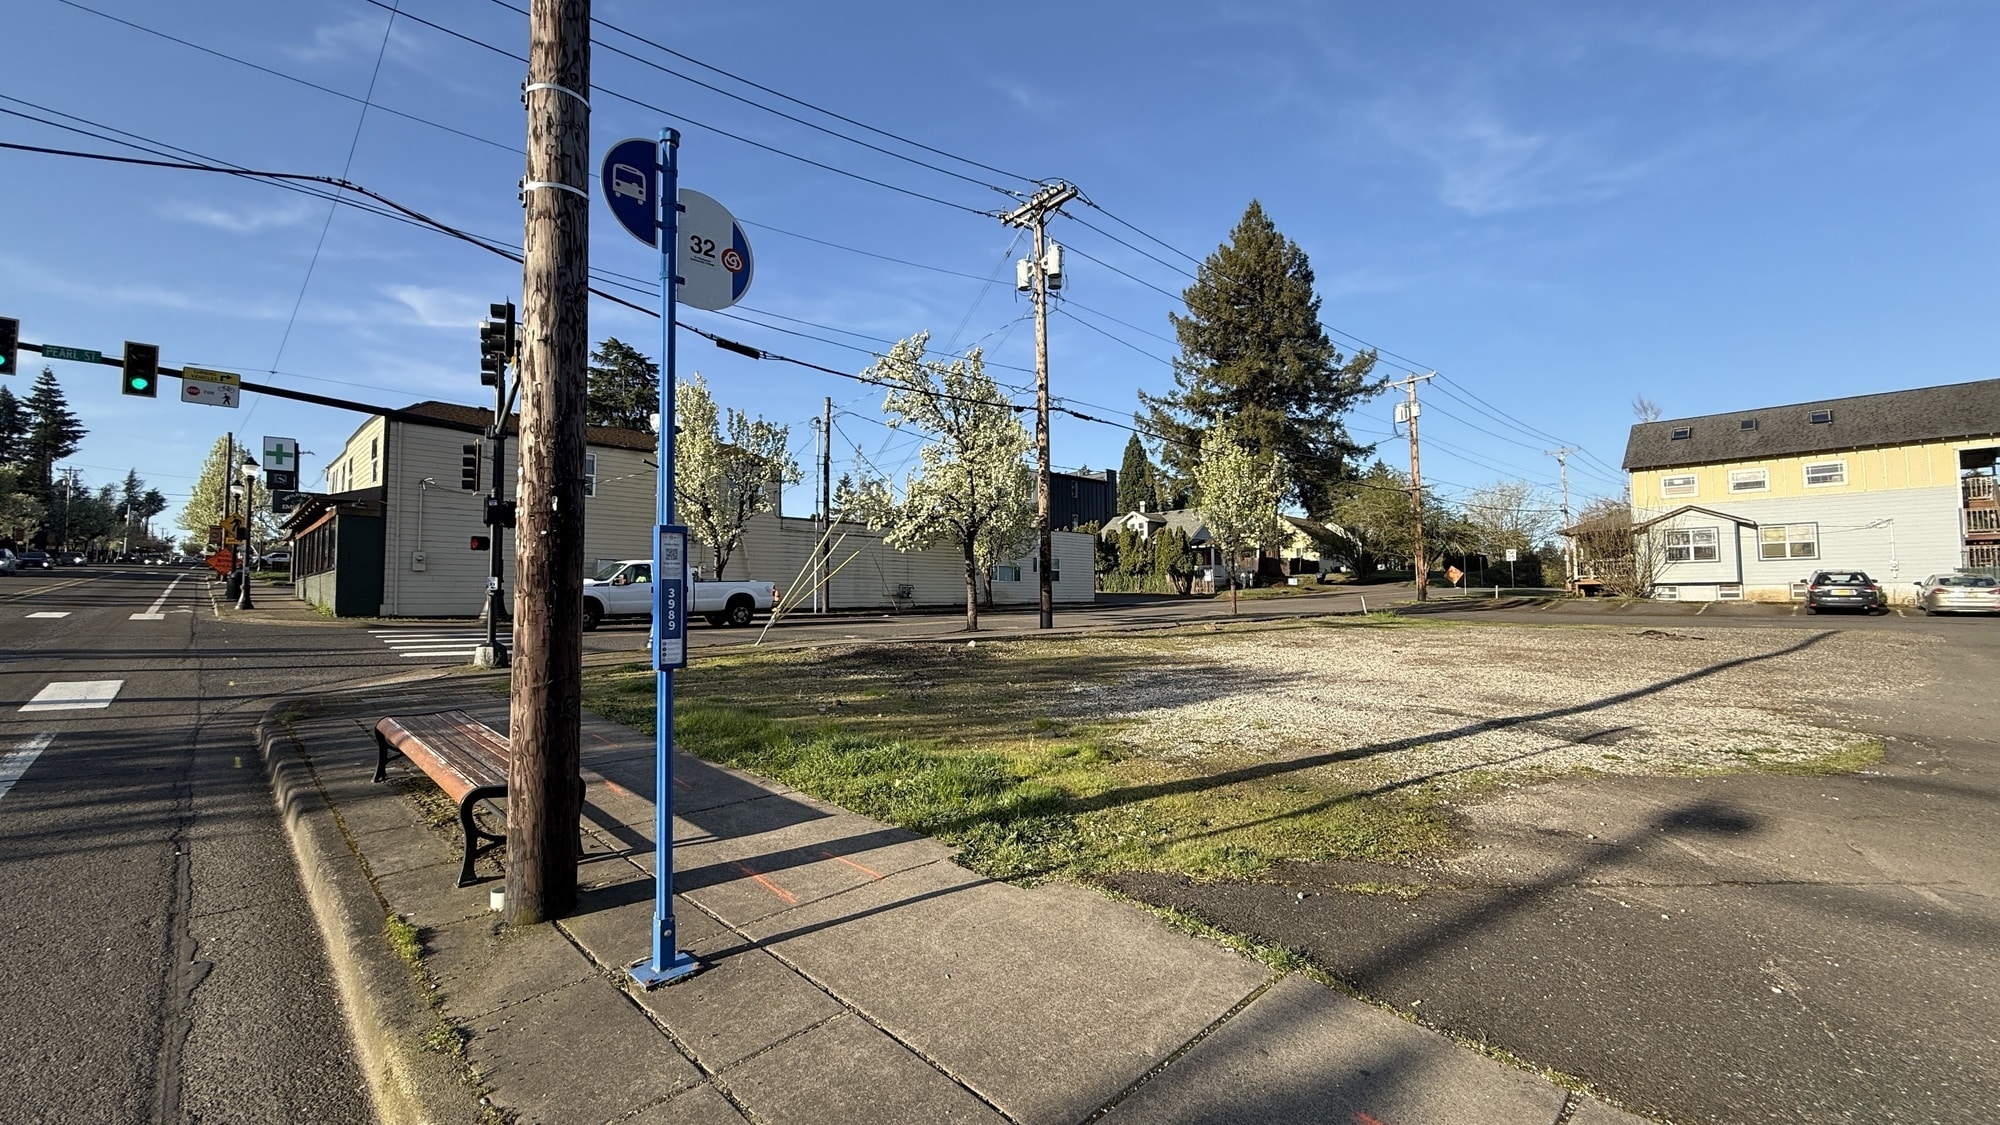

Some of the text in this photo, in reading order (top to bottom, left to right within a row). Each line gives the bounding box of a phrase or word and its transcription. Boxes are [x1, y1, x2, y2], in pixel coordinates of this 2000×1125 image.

[690, 235, 715, 258] 32
[46, 346, 97, 361] PEARL ST
[667, 588, 676, 631] 3989
